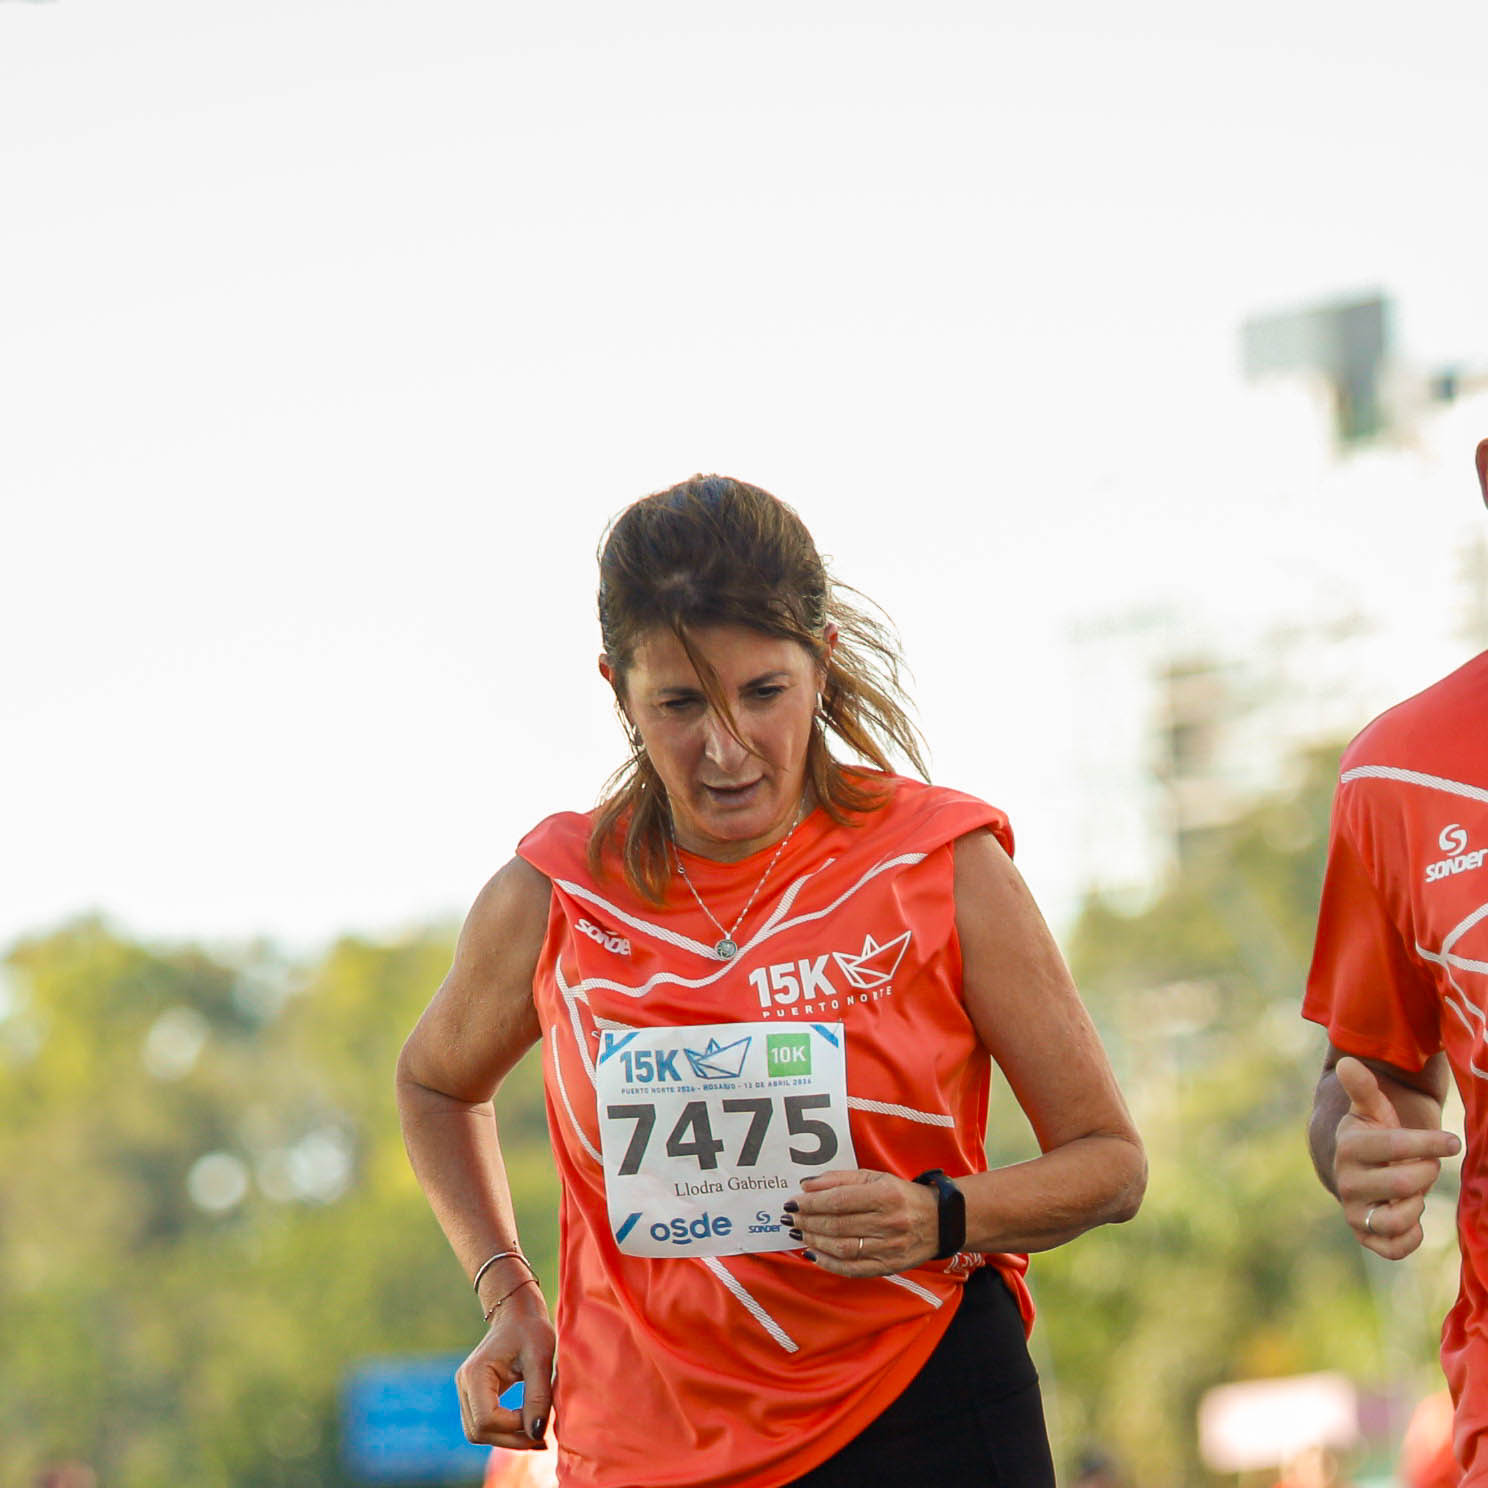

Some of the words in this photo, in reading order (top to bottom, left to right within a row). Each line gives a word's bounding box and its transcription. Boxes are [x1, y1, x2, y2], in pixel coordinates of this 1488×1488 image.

[748, 953, 837, 1008] 15K
[763, 1000, 839, 1018] PUERTO
[847, 986, 893, 1006] NORTE
[620, 1049, 683, 1083] 15K
[771, 1046, 807, 1064] 10K
[607, 1093, 838, 1176] 7475
[674, 1180, 723, 1197] Llodra
[727, 1175, 788, 1191] Gabriela
[649, 1211, 733, 1245] osde
